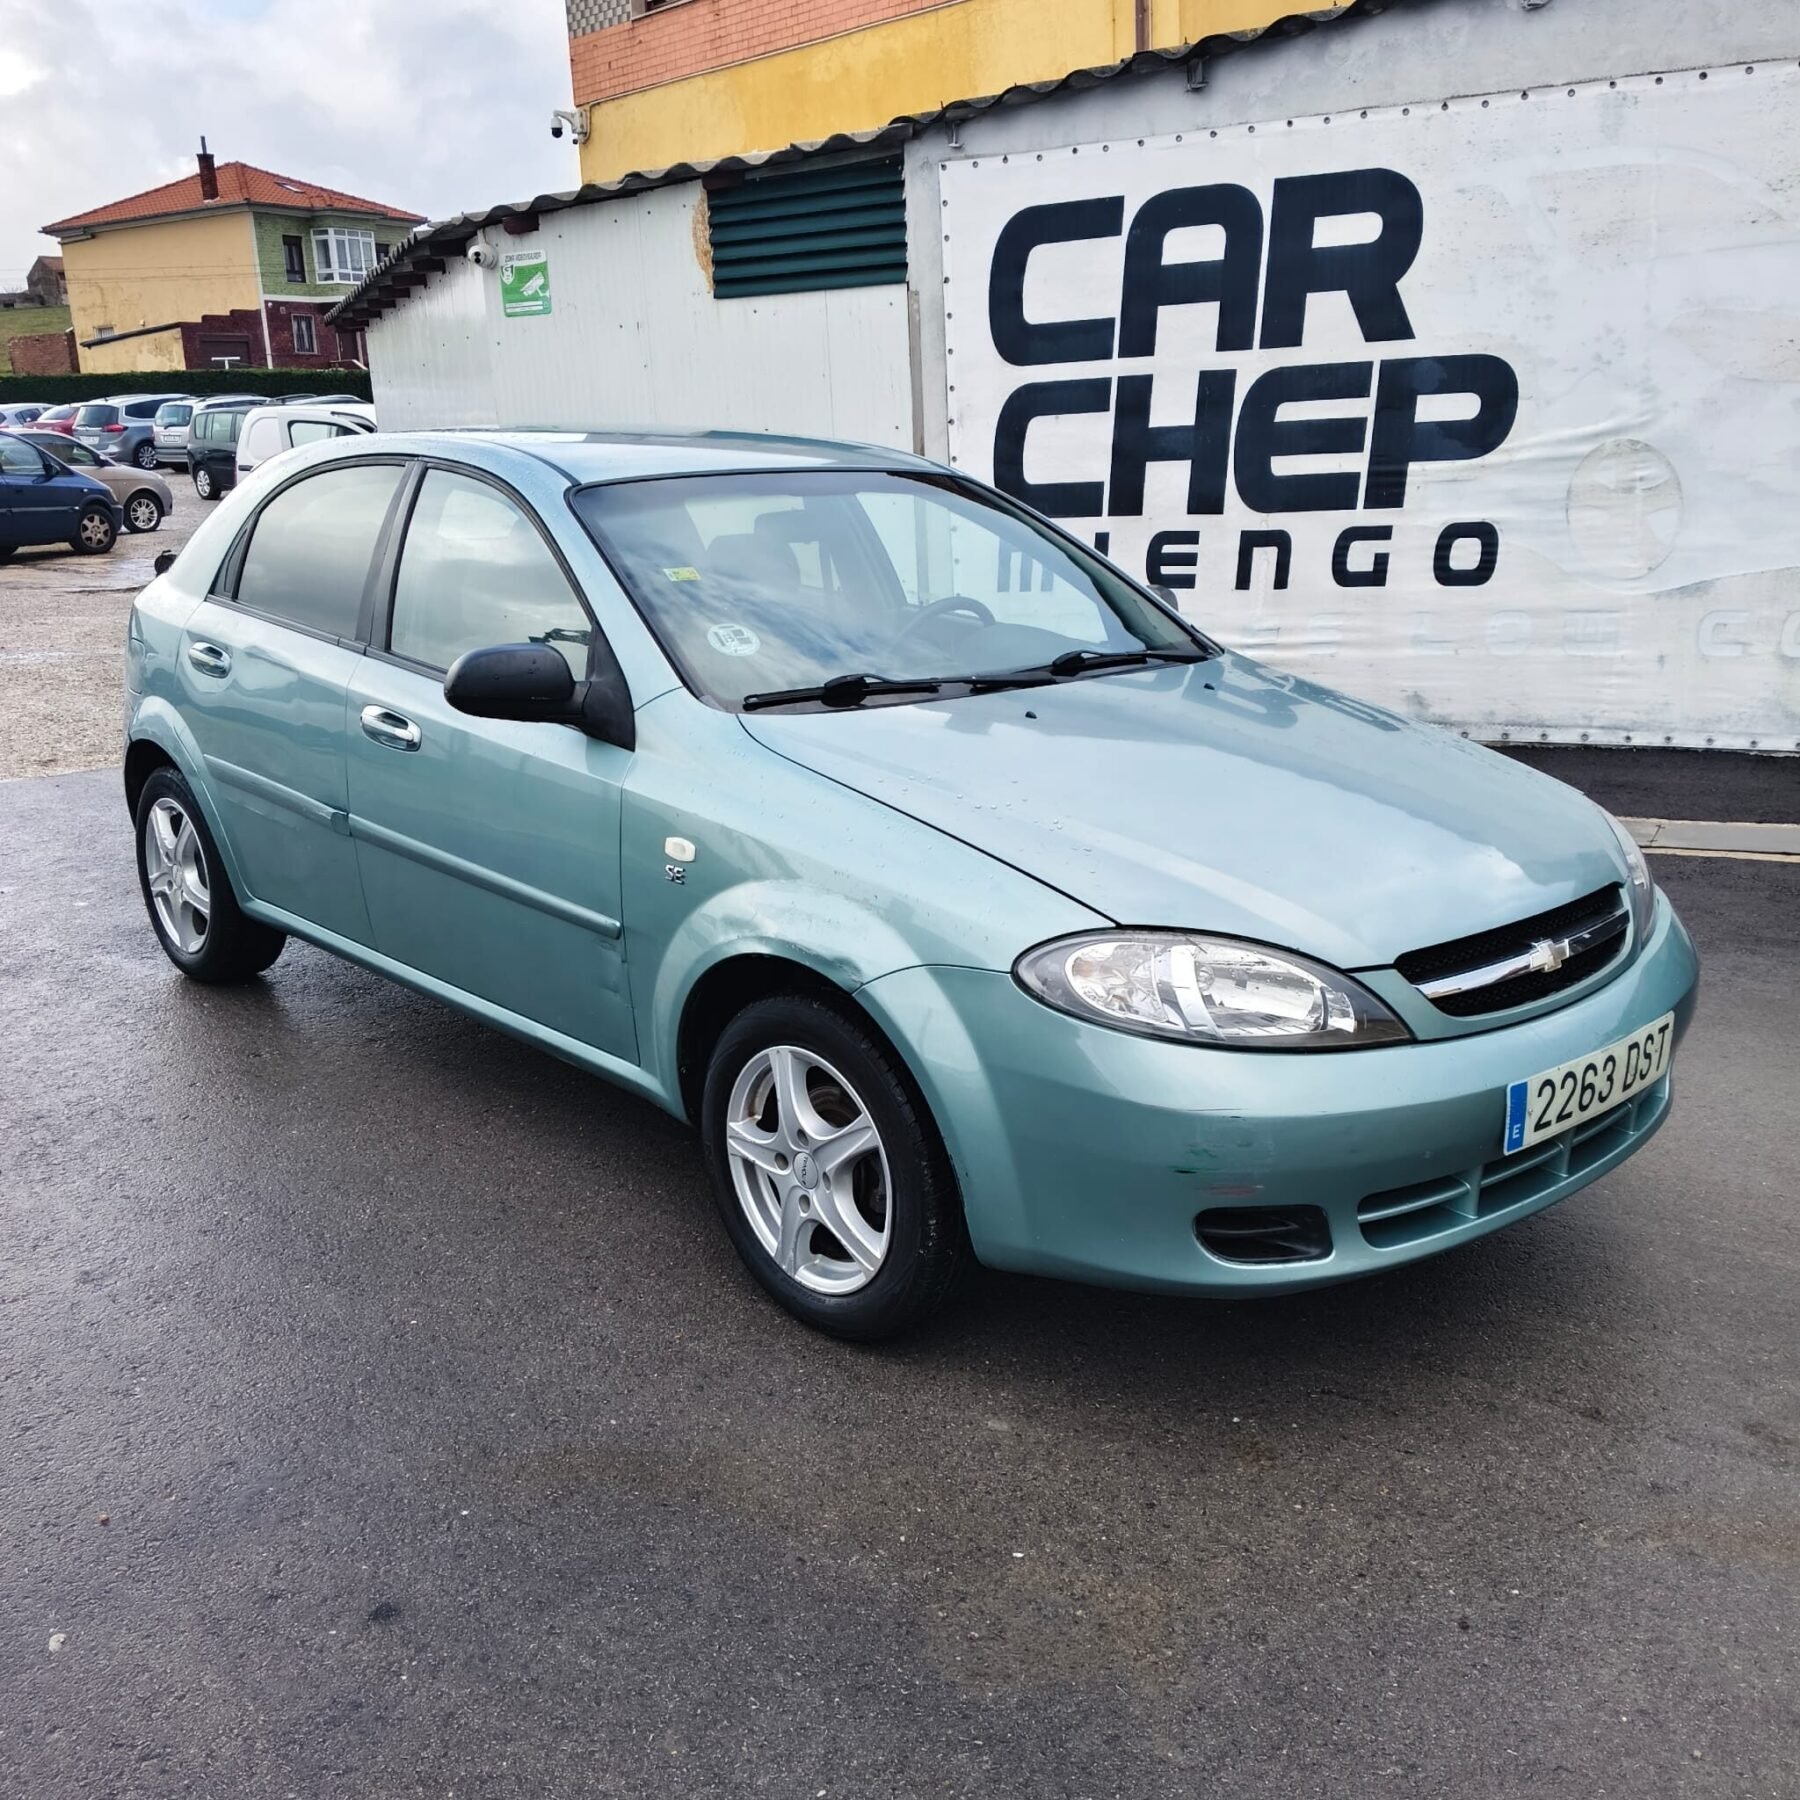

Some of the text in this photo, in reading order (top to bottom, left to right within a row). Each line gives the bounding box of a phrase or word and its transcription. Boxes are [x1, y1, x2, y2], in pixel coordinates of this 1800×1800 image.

[988, 167, 1424, 367] CAR
[993, 354, 1520, 518] CHEP
[1512, 1123, 1521, 1139] E
[1533, 1022, 1669, 1133] 2263 DST
